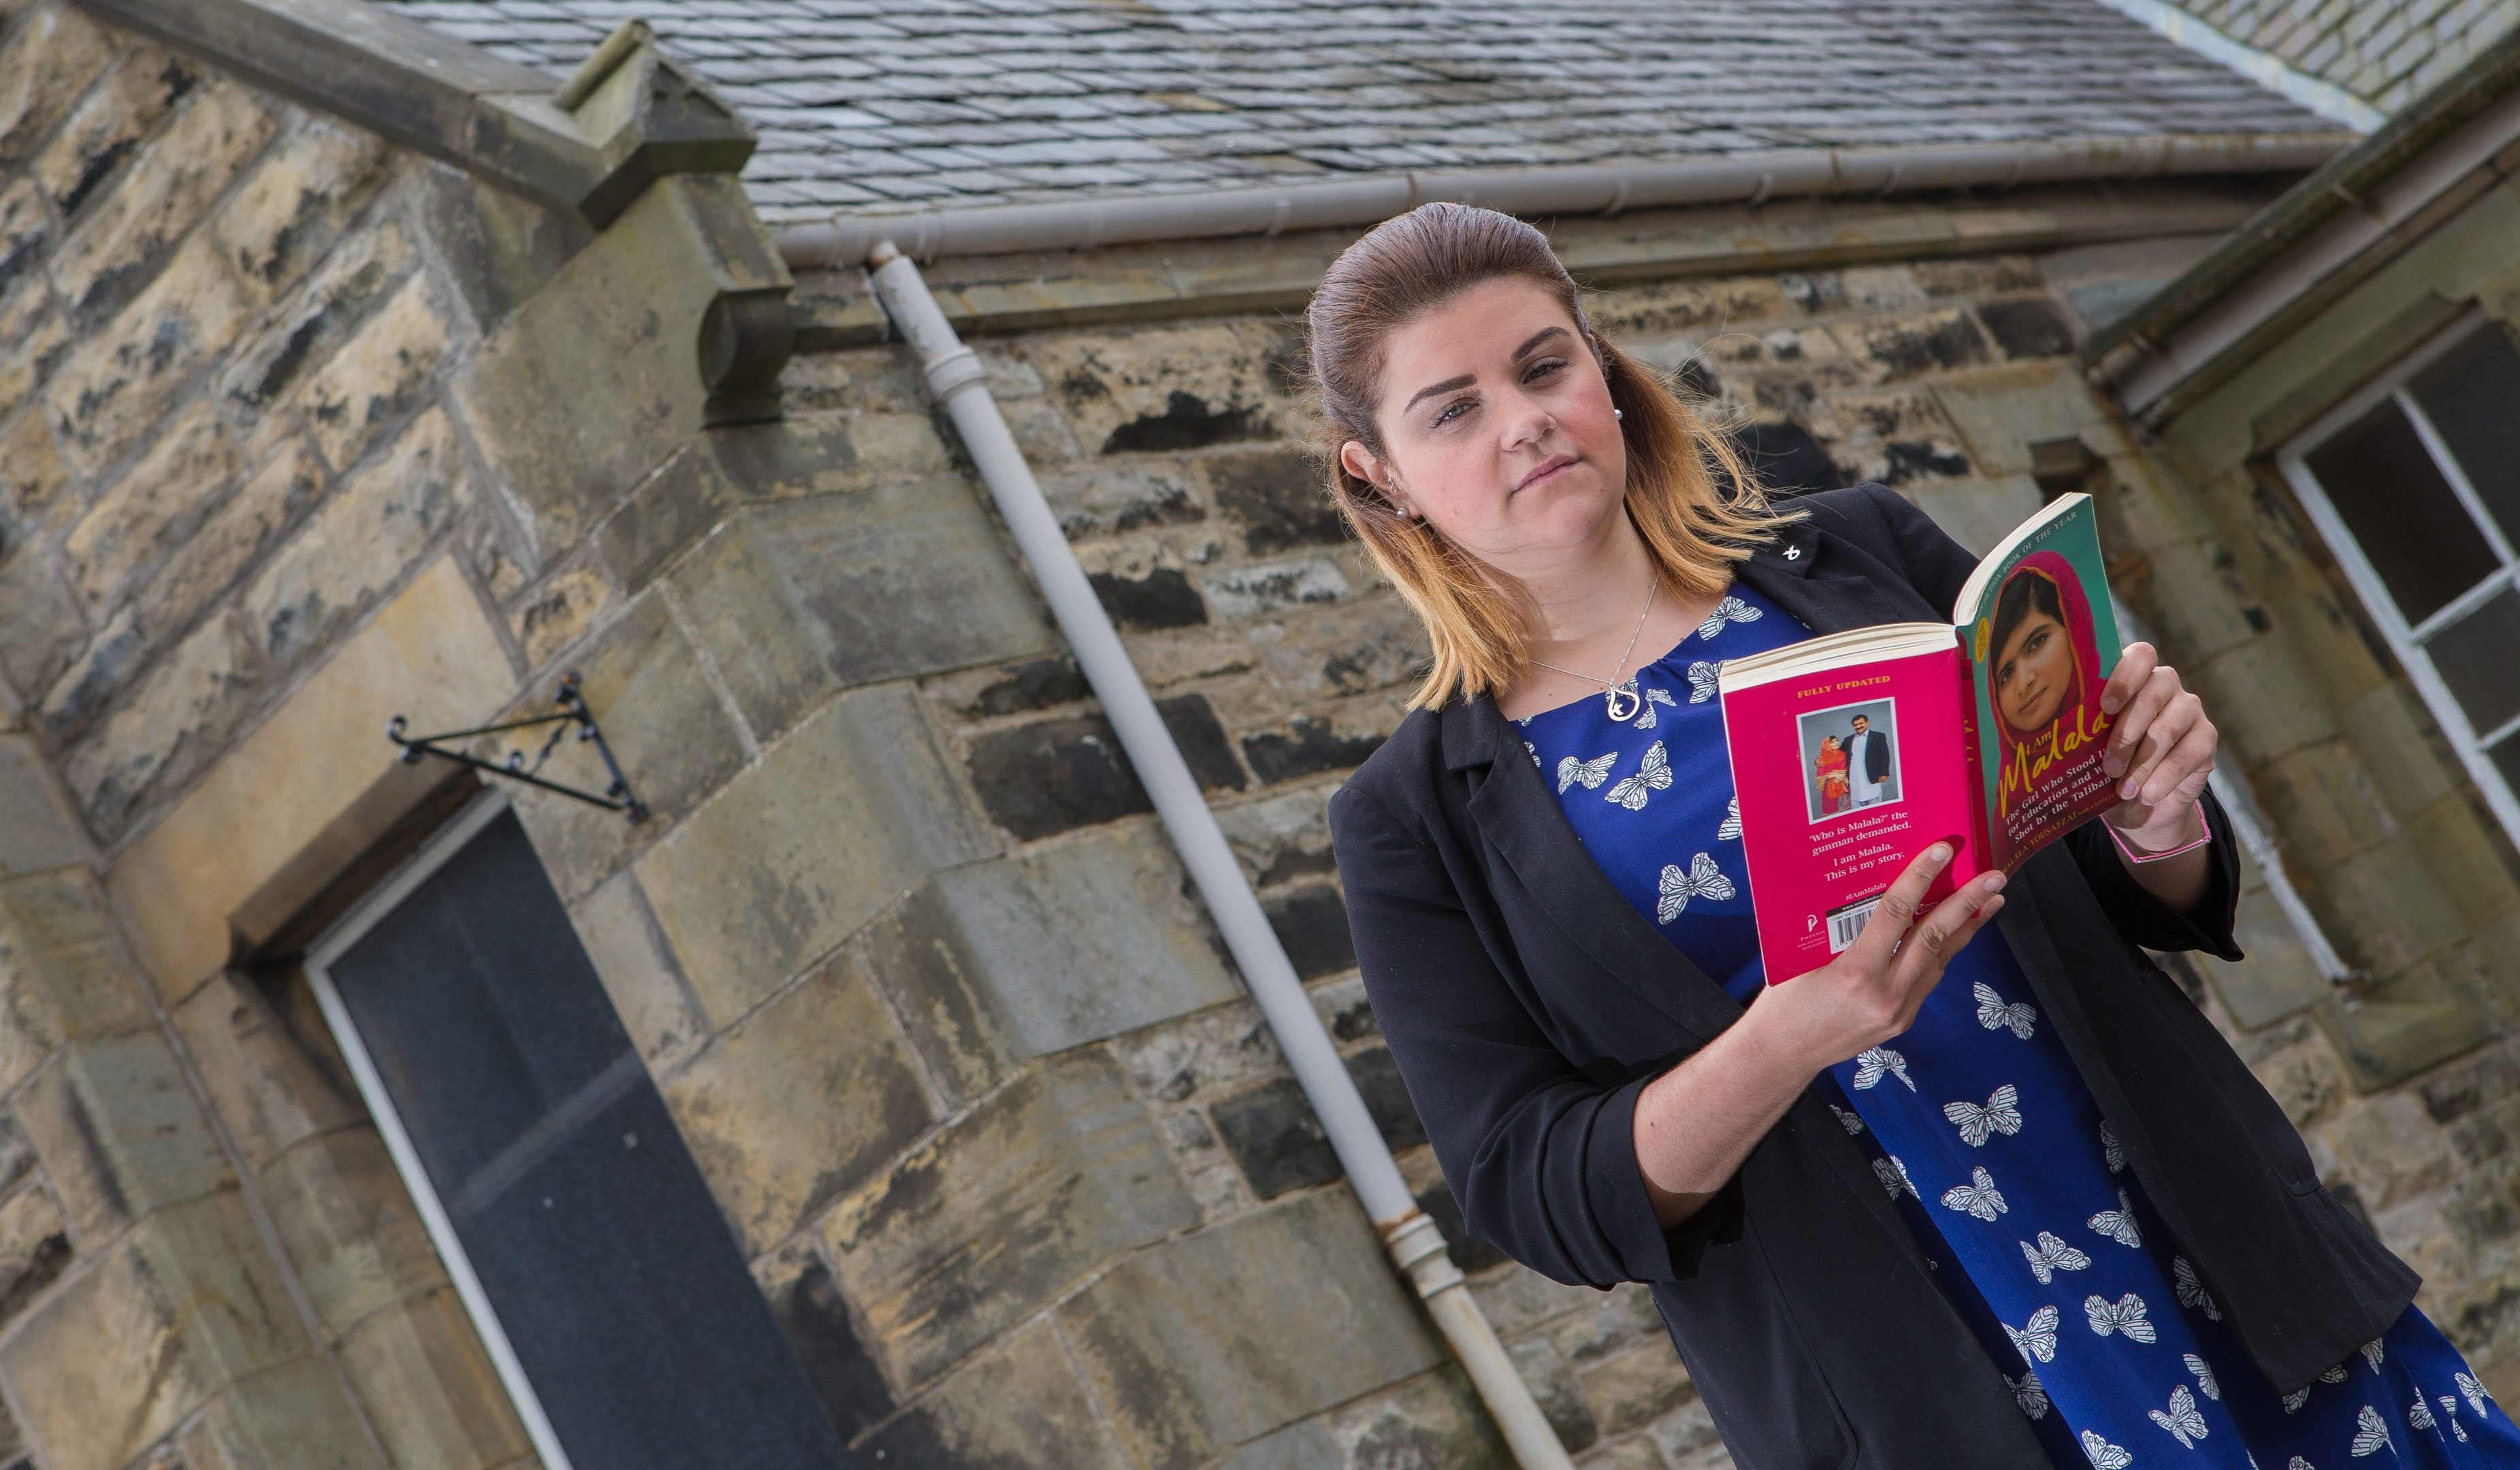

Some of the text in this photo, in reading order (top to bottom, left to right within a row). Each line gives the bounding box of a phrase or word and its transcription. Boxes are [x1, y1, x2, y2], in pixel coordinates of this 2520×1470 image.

[2003, 511, 2078, 574] BOOK OF THE YEAR
[1797, 675, 1891, 698] FULLY UPDATED
[2026, 731, 2052, 755] I Am
[1999, 704, 2110, 819] Malala
[2005, 808, 2020, 826] The
[2022, 791, 2039, 809] Girl
[2041, 777, 2063, 794] Who
[2066, 755, 2096, 778] Stood
[2008, 772, 2092, 837] for Education and
[1837, 827, 1846, 835] is
[1891, 811, 1908, 821] the
[2014, 776, 2112, 844] Shot by the Taliban
[1812, 821, 1911, 856] gunman demanded.
[1833, 843, 1893, 866] I am Malala.
[2001, 845, 2029, 874] MALALA
[2030, 811, 2077, 846] YOUSAFZAI
[1824, 851, 1905, 881] This is my story.
[1845, 883, 1887, 900] #IAmMalala
[1800, 930, 1826, 941] PHOENIX
